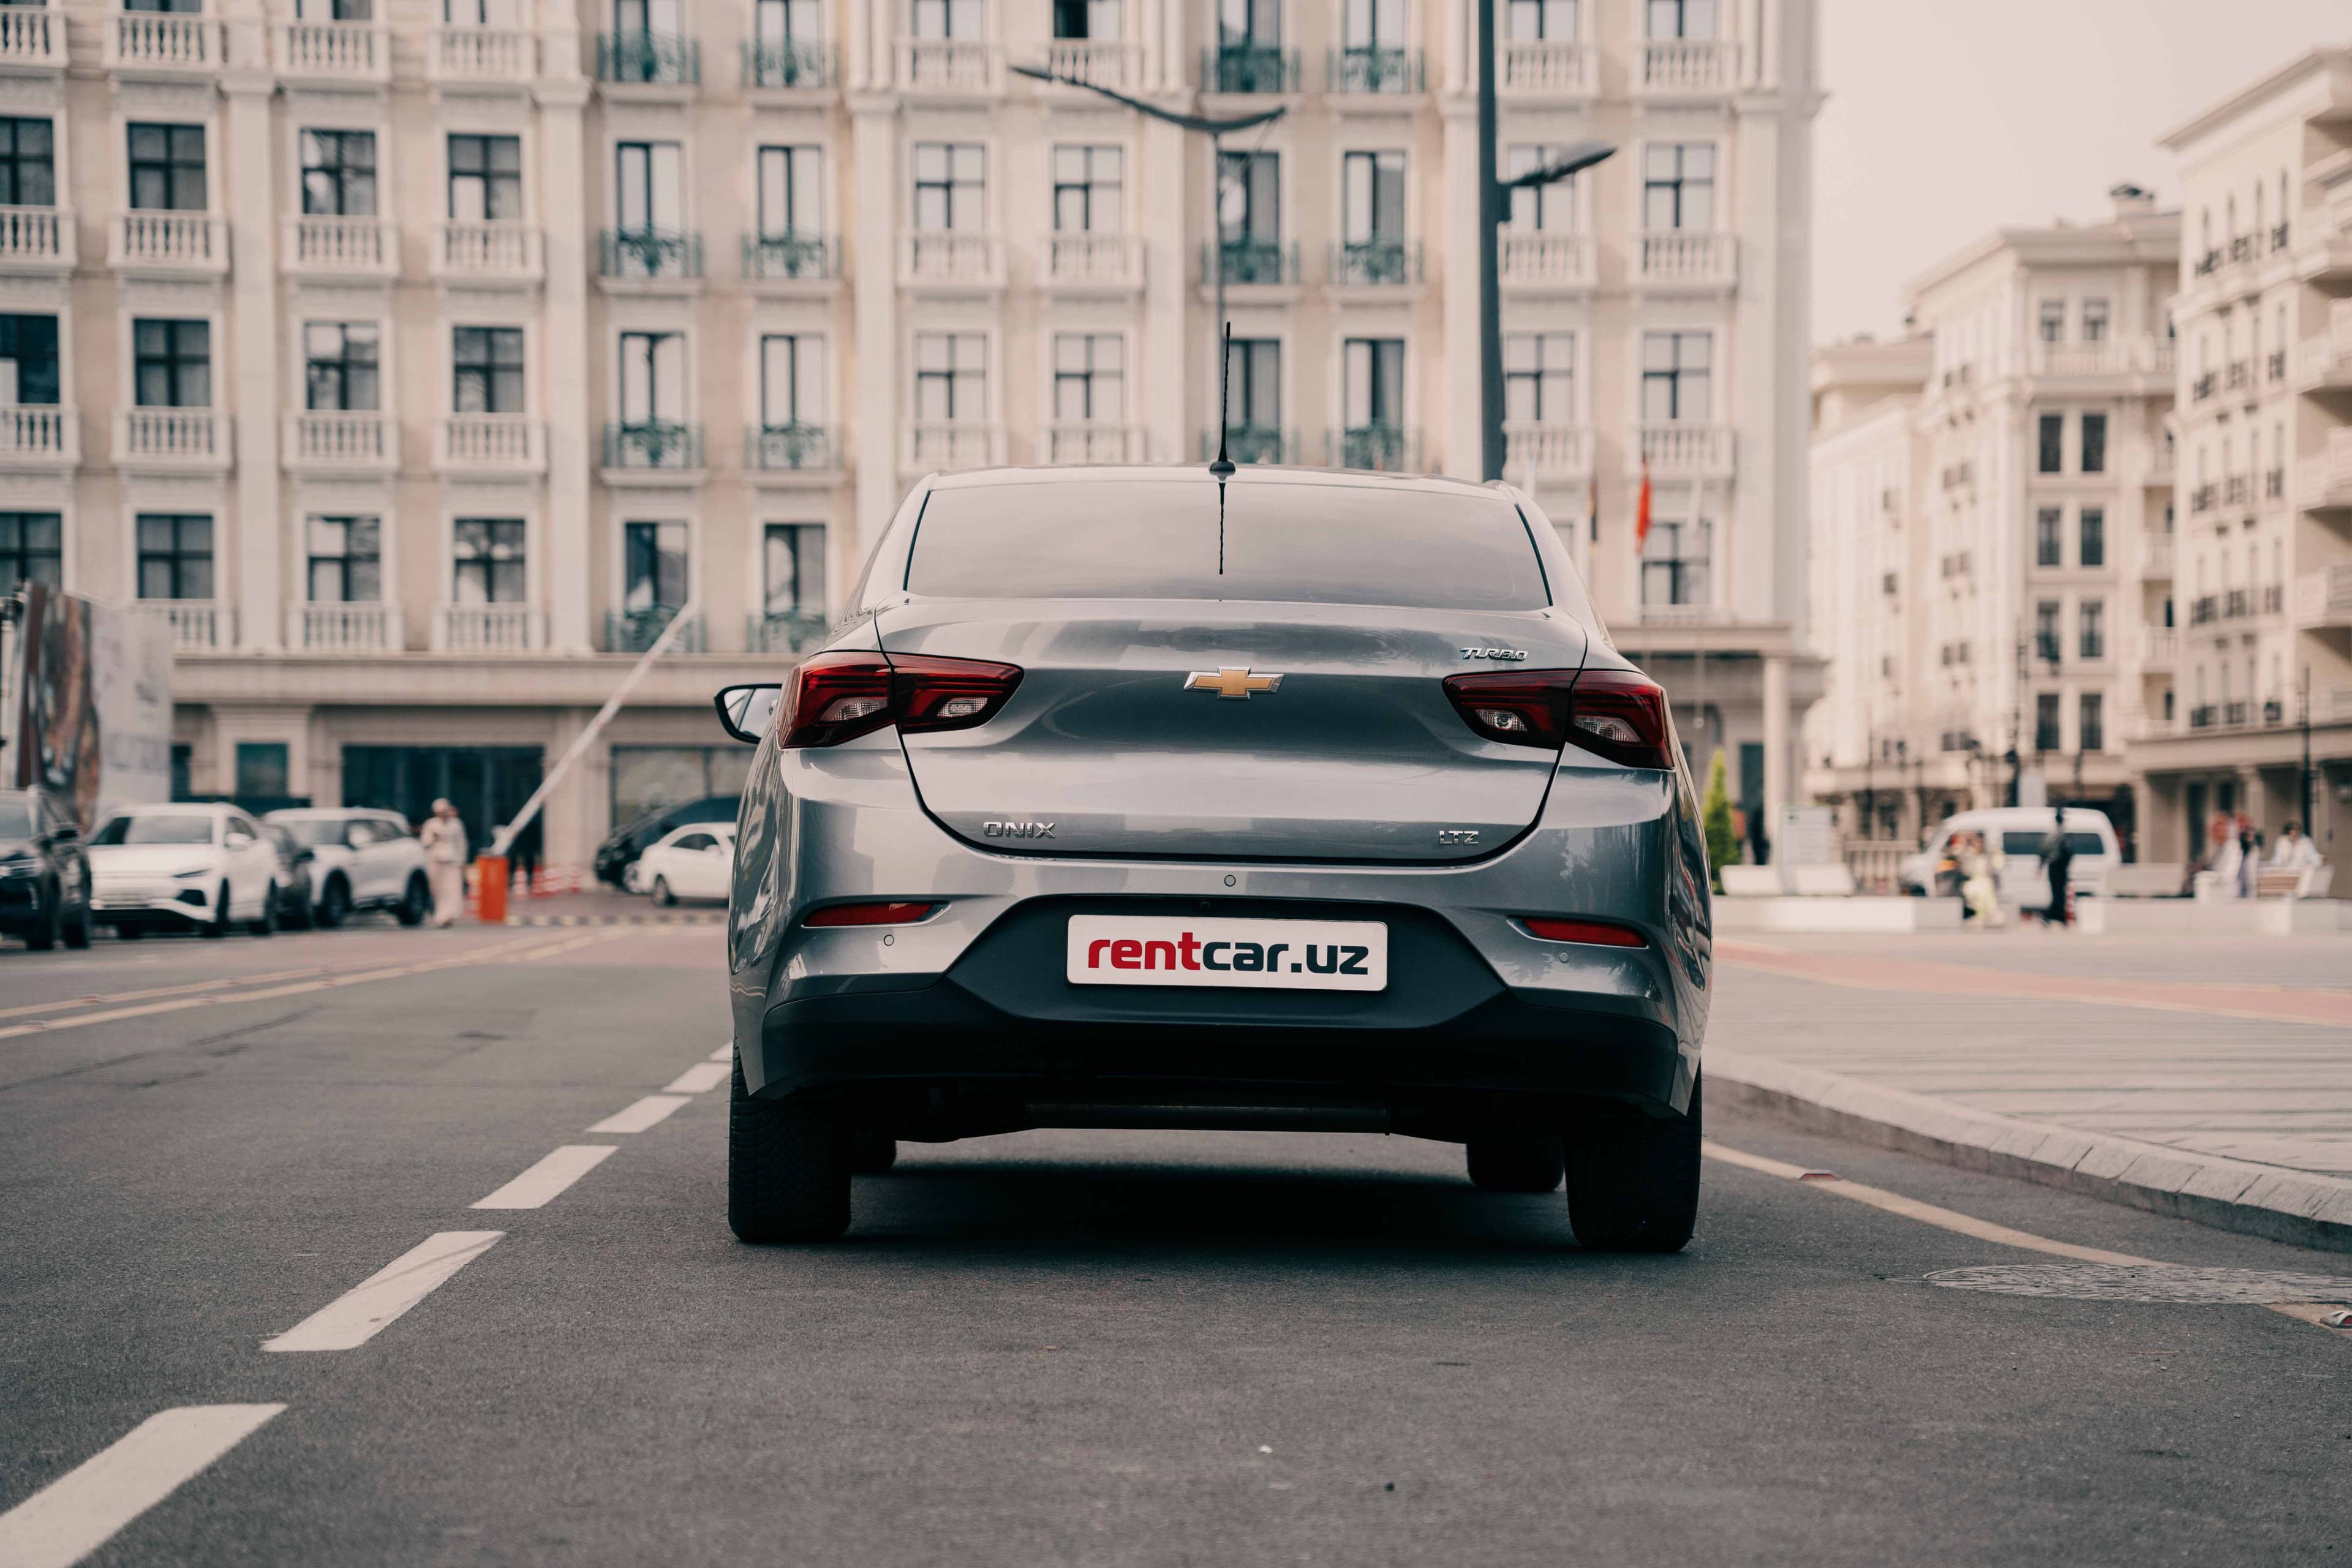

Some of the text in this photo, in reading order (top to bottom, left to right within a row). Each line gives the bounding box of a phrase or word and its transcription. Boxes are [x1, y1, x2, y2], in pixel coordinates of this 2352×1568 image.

[1460, 647, 1529, 662] TURBO
[983, 821, 1055, 838] ONIX
[1439, 830, 1479, 845] LTZ
[1088, 932, 1369, 975] rentcar.uz
